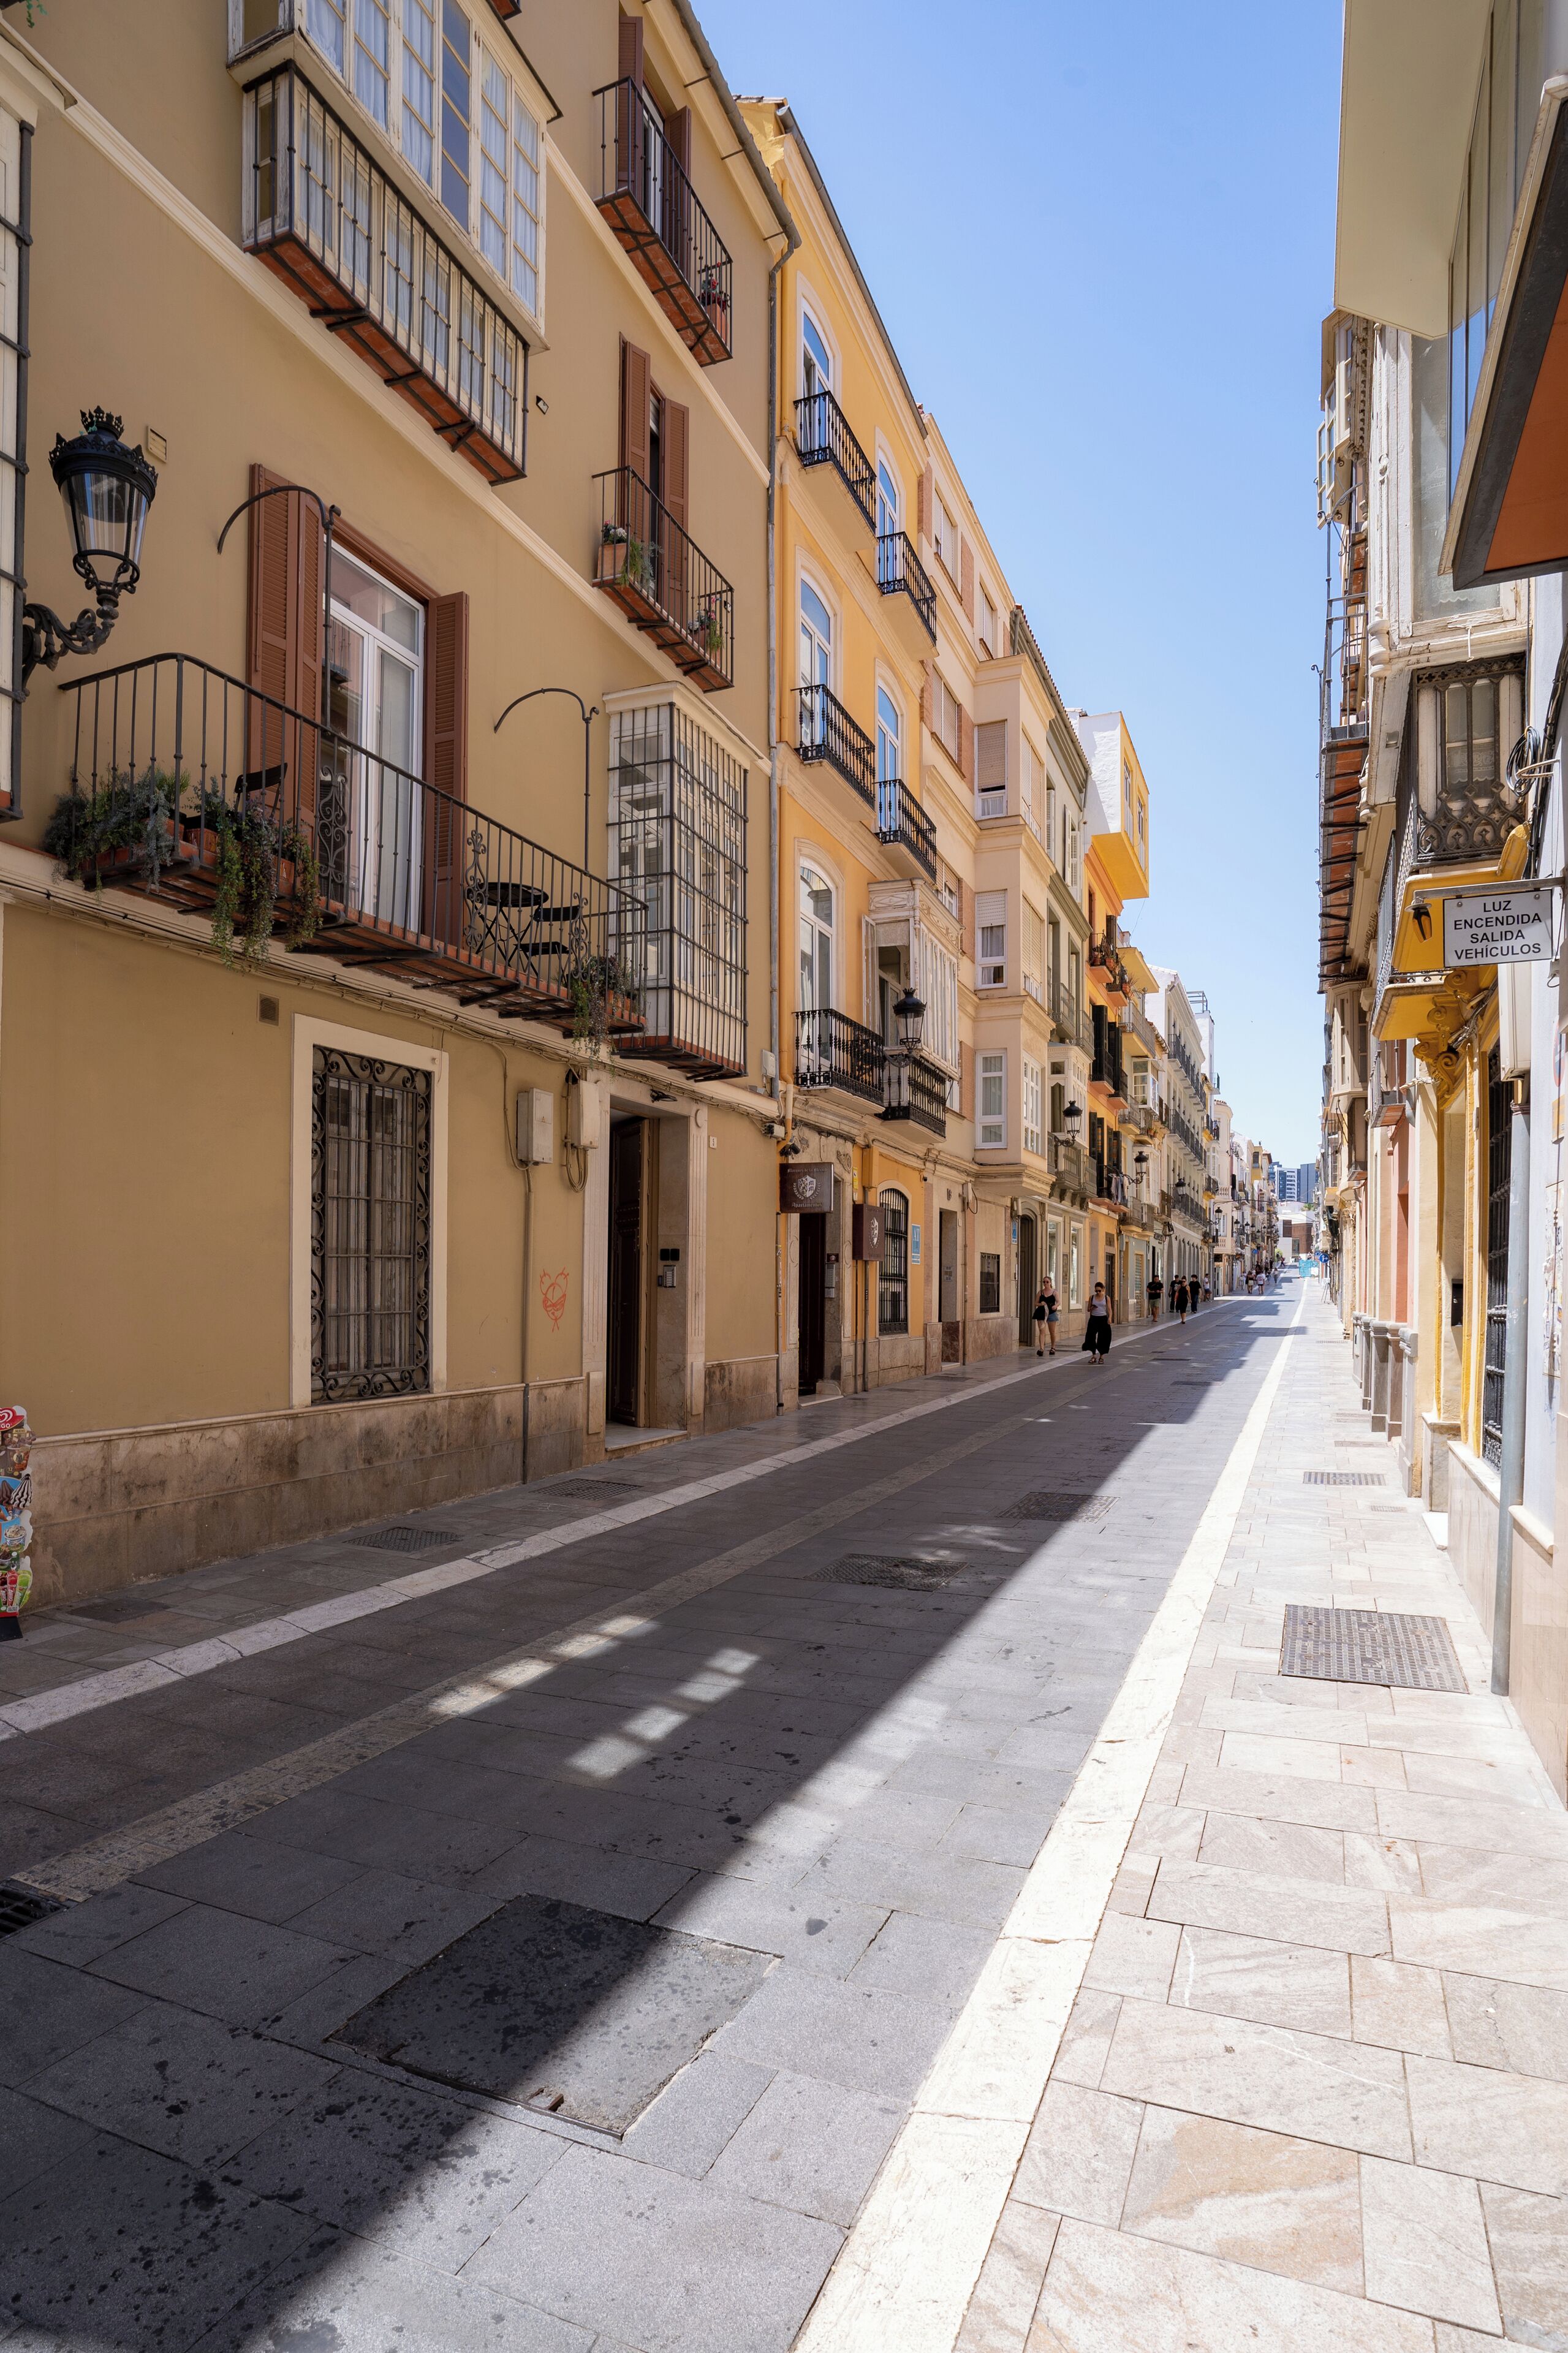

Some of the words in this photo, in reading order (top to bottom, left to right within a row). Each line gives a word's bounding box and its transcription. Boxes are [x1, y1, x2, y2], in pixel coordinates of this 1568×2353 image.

[1483, 900, 1512, 912] LUZ
[1454, 912, 1542, 930] ENCENDIDA
[1470, 930, 1525, 944] SALIDA
[1455, 943, 1541, 960] VEHÍCULOS
